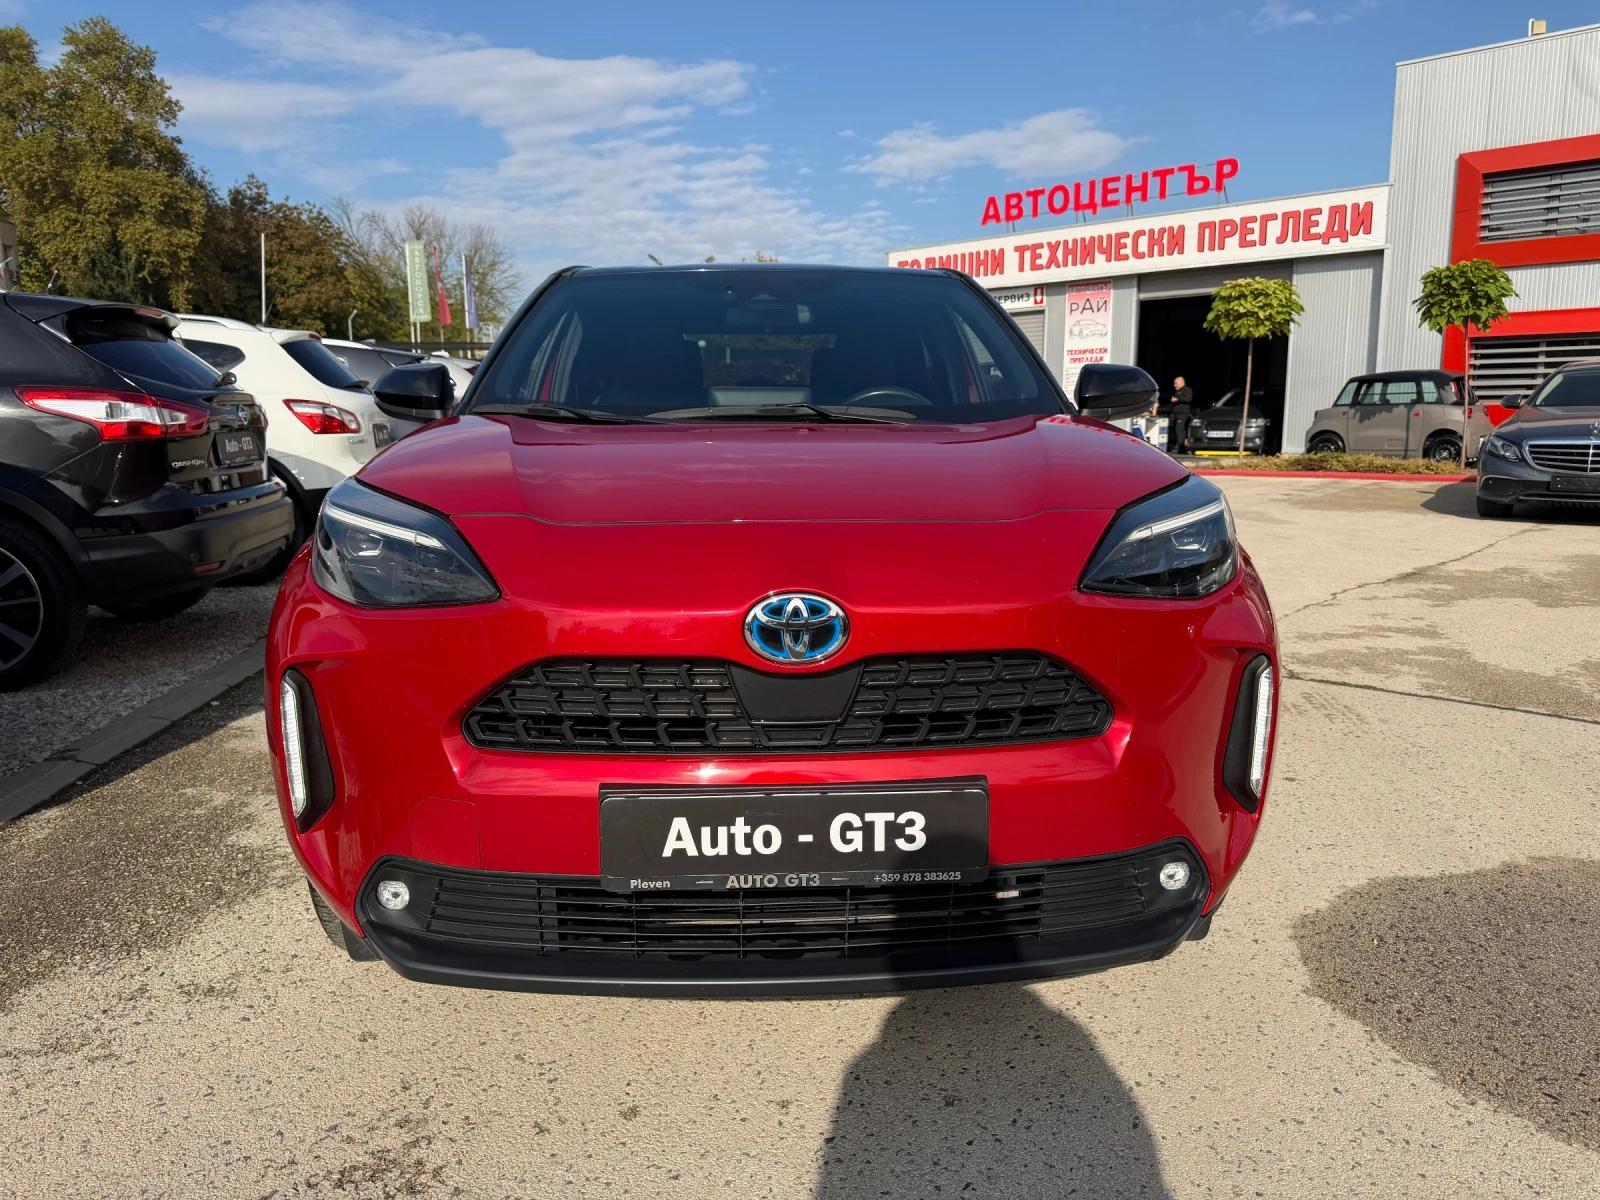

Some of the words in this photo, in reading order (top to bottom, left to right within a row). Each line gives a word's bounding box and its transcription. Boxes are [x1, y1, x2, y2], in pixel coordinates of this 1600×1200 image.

[981, 158, 1239, 226] АВТОЦЕНТЪР
[1014, 224, 1186, 272] ТЕХНИЧЕСКИ
[1196, 201, 1374, 253] ПРЕГЛЕДИ
[994, 292, 1030, 304] ЕРВИЗ
[1066, 347, 1108, 356] ТЕХНИЧЕСКИ
[225, 438, 239, 453] Auto
[241, 436, 253, 451] GT3
[662, 816, 782, 857] Auto
[829, 811, 927, 853] GT3
[630, 879, 671, 889] Pleven
[726, 873, 779, 889] AUTO
[784, 873, 820, 887] GT3
[873, 873, 900, 882] +359
[902, 872, 922, 882] 878
[924, 871, 962, 881] 383625
